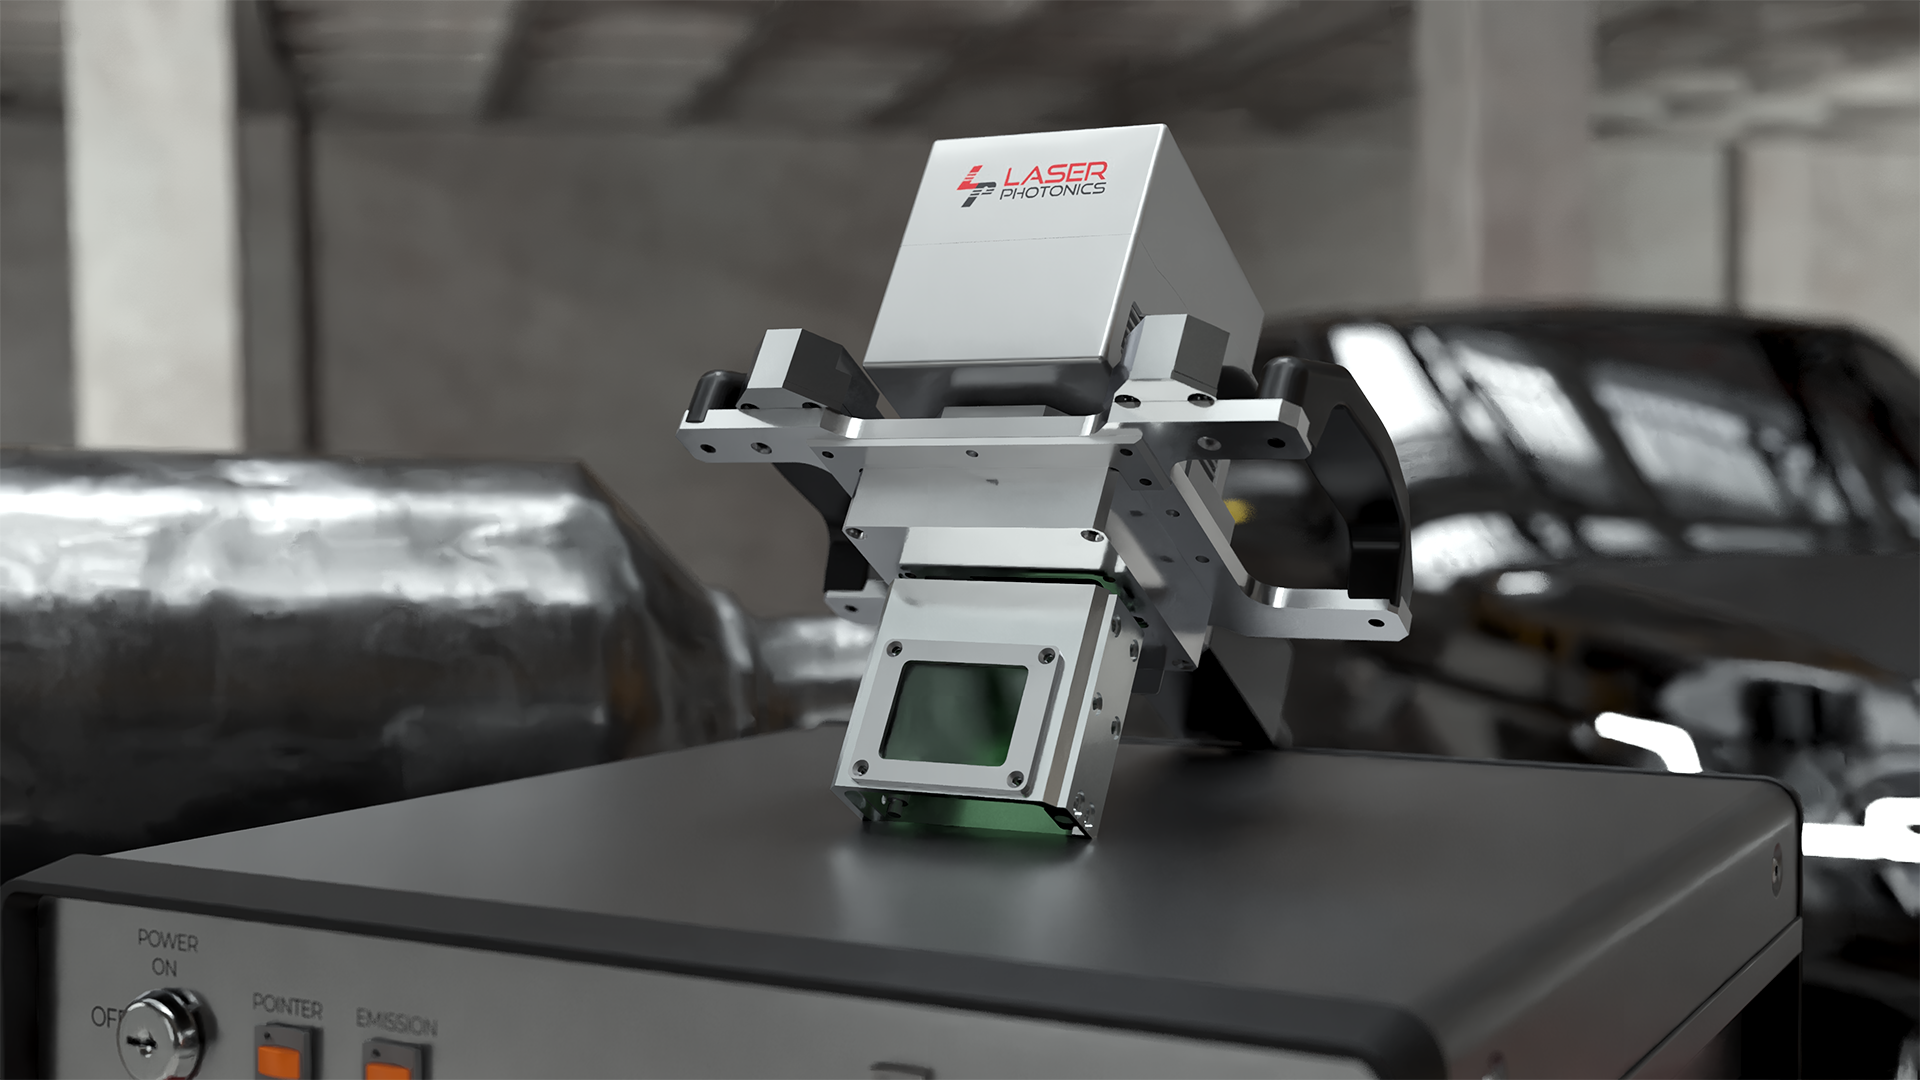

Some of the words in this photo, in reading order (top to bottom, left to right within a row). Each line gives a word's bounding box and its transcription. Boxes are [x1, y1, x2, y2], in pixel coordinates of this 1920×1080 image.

[1003, 161, 1108, 187] LASER
[999, 181, 1107, 200] PHOTONICS
[138, 928, 199, 953] POWER
[152, 957, 178, 978] ON
[253, 992, 324, 1020] POINTER
[356, 1006, 439, 1037] EMISSION
